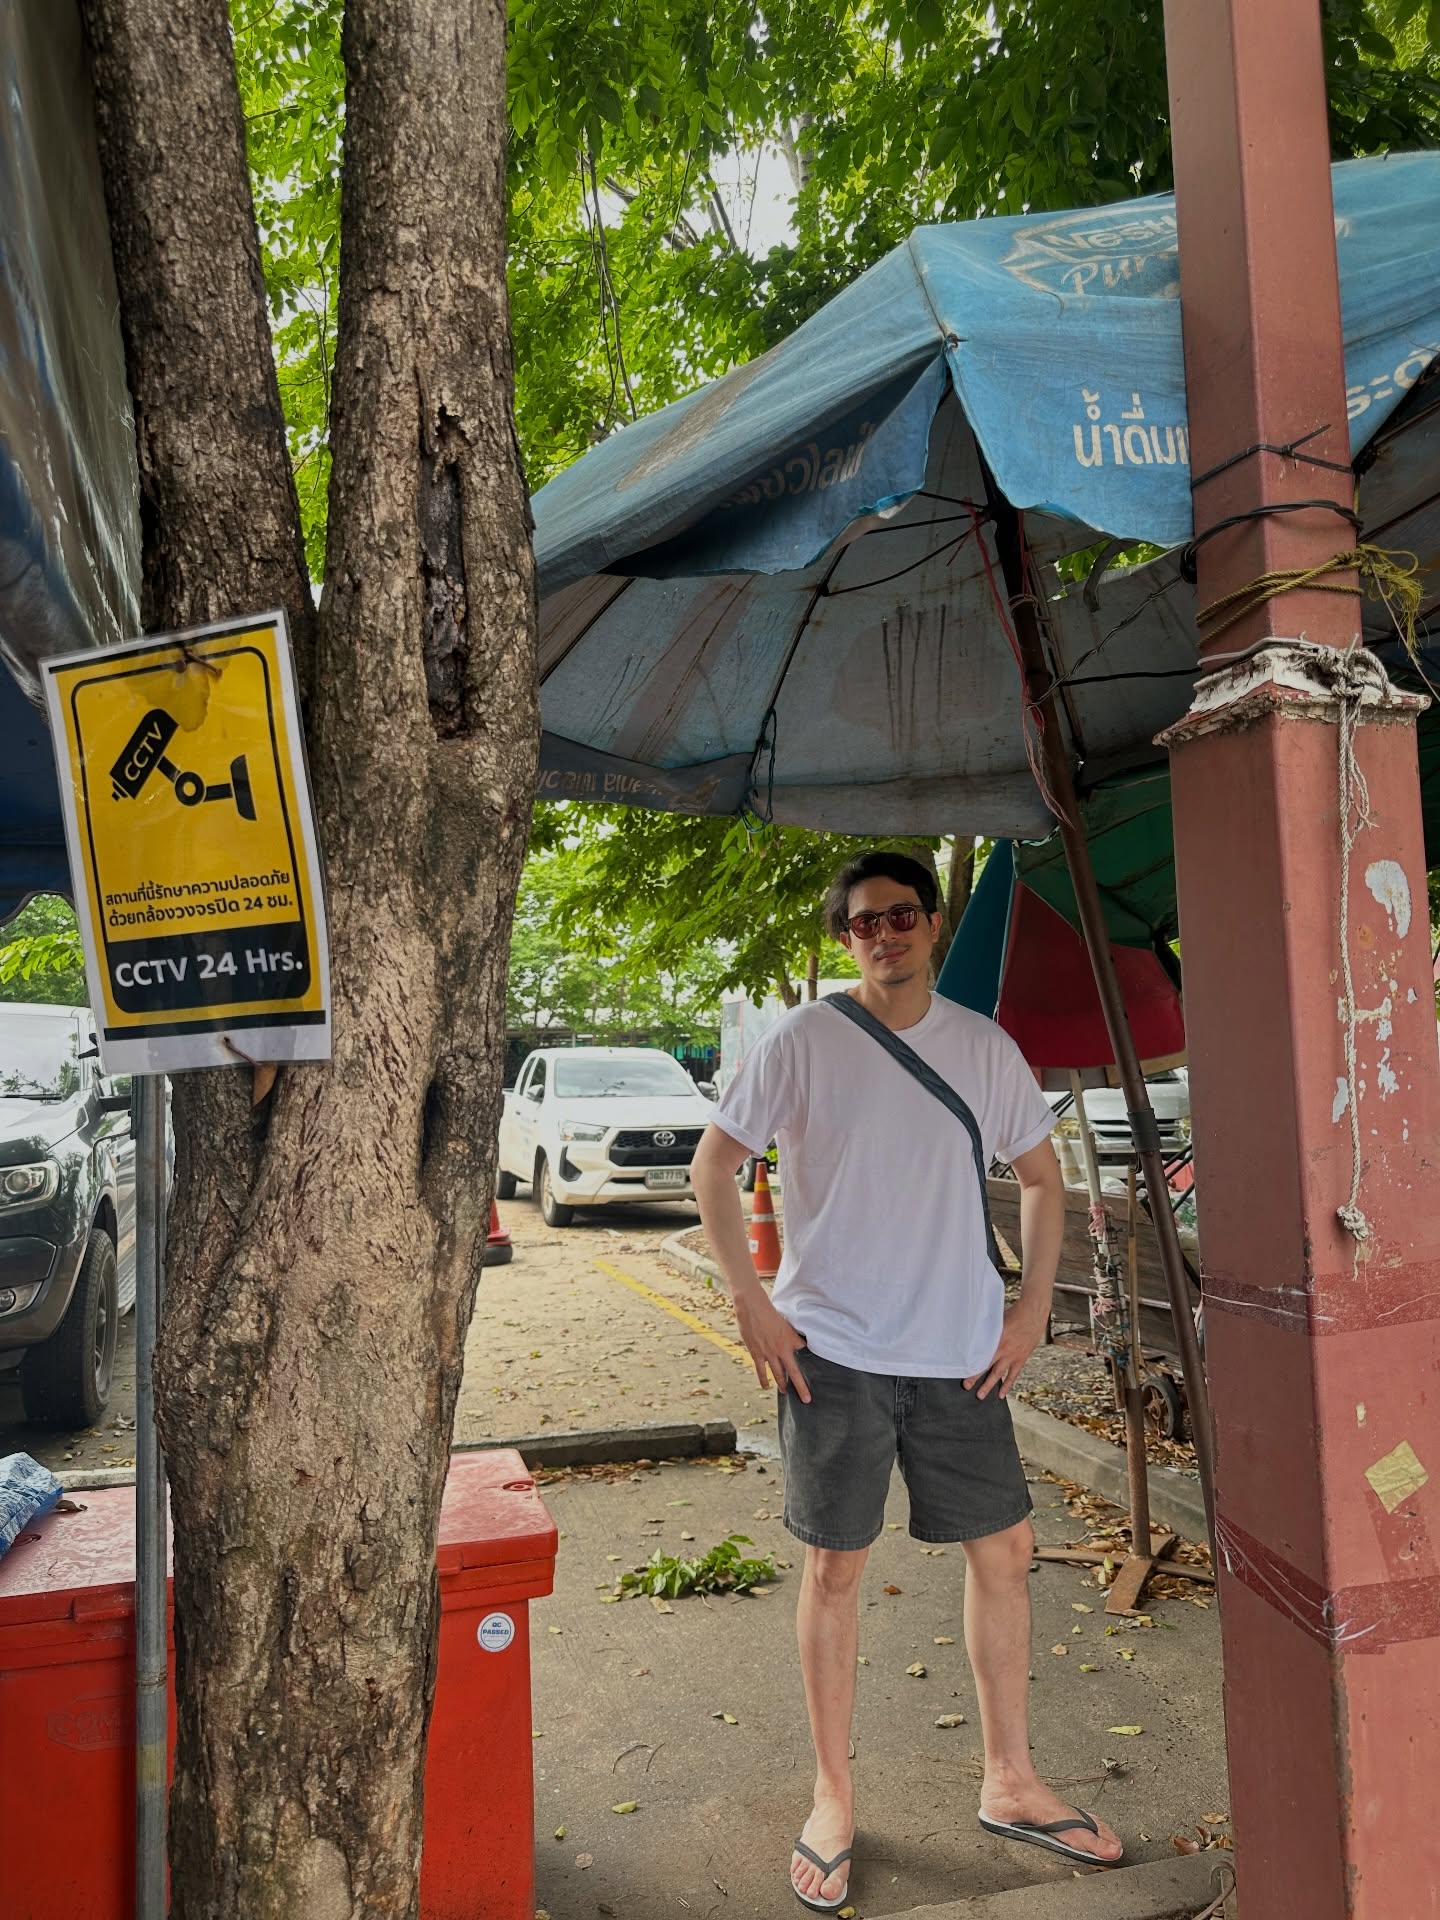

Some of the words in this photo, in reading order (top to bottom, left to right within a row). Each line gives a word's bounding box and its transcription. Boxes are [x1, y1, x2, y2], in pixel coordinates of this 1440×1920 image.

[125, 721, 162, 781] CCTV
[105, 869, 291, 906] สถานที่นี้รักษาความปลอดภัย
[109, 899, 240, 927] ด้วยกล้องวงจรปิด
[244, 897, 263, 911] 24
[267, 894, 294, 908] ชม.
[115, 957, 188, 988] CCTV
[196, 951, 239, 980] 24
[245, 948, 304, 975] Hrs.
